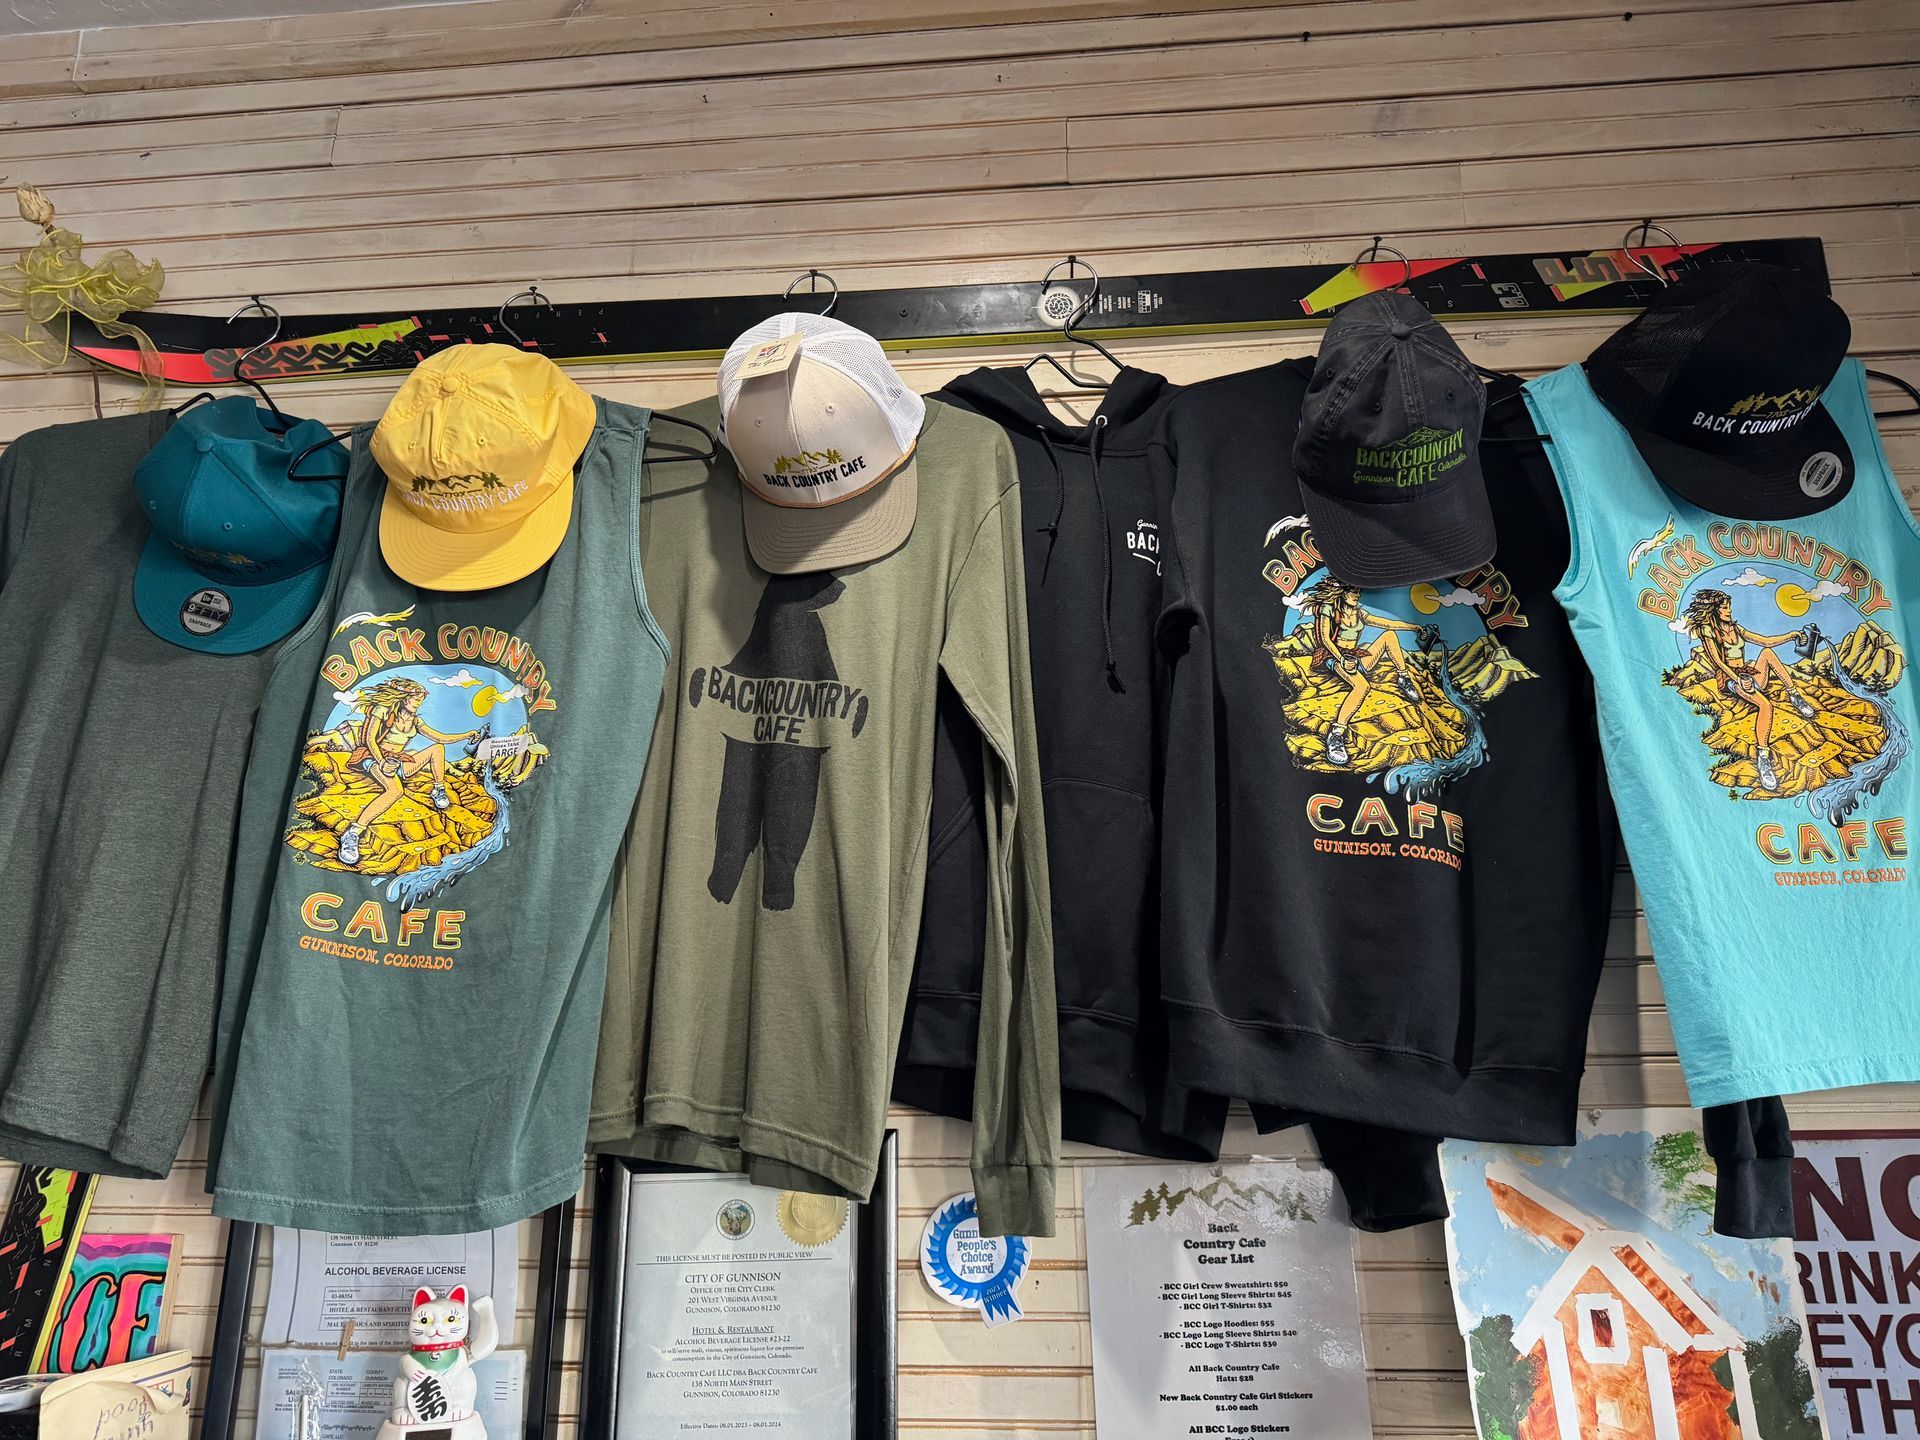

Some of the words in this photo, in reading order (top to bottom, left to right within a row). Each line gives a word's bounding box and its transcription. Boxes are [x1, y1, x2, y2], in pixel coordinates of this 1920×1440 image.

[1692, 411, 1736, 434] BACK
[1739, 411, 1802, 435] COUNTRY
[1356, 428, 1464, 469] BACKCOUNTRY
[1438, 452, 1467, 472] Colorado
[763, 473, 791, 489] BACK
[792, 467, 838, 488] COUNTRY
[840, 456, 867, 477] CAFE
[1353, 470, 1394, 484] Gunnison
[1396, 461, 1437, 488] CAFE
[432, 494, 494, 512] COUNTRY
[498, 480, 529, 505] CAFE
[1262, 529, 1324, 597] BAC
[1637, 535, 1714, 622] BACK
[1707, 521, 1893, 616] COUNTRY
[189, 617, 212, 629] SNAPBACK
[320, 624, 434, 692] BACK
[437, 623, 557, 715] COUNTRY
[707, 665, 862, 720] BACKCOUNTRY
[753, 715, 806, 744] CAFE
[490, 748, 519, 759] LARGE
[1306, 793, 1465, 853] CAFE
[1756, 817, 1908, 865] CAFE
[1313, 838, 1396, 857] GUNNISON,
[1399, 843, 1463, 873] COLORADO
[1774, 870, 1843, 887] GUNNISON,
[300, 891, 466, 950] CAFE
[299, 935, 380, 965] GUNNISON,
[383, 952, 454, 971] COLORADO
[953, 1229, 978, 1239] Gunn
[1207, 1223, 1239, 1233] Back
[957, 1239, 997, 1252] People's
[1183, 1239, 1235, 1250] Country
[1239, 1238, 1266, 1248] Cafe
[961, 1252, 993, 1263] Choice
[1198, 1254, 1227, 1264] Gear
[1230, 1254, 1254, 1263] List
[324, 1266, 370, 1276] ALCOHOL
[372, 1266, 424, 1276] BEVERAGE
[426, 1266, 466, 1275] LICENSE
[960, 1263, 995, 1275] Award
[685, 1274, 707, 1283] CITY
[710, 1273, 724, 1283] OF
[726, 1272, 781, 1282] GUNNISON
[1182, 1331, 1201, 1339] Logo
[1204, 1331, 1223, 1339] Long
[1225, 1330, 1251, 1338] Sleeve
[1204, 1341, 1223, 1349] Logo
[1225, 1365, 1260, 1373] Country
[1278, 1391, 1312, 1399] Stickers
[1215, 1404, 1237, 1412] $1.00
[1189, 1425, 1202, 1433] All
[1205, 1425, 1223, 1433] BCC
[1225, 1425, 1248, 1435] Logo
[1251, 1424, 1289, 1432] Stickers
